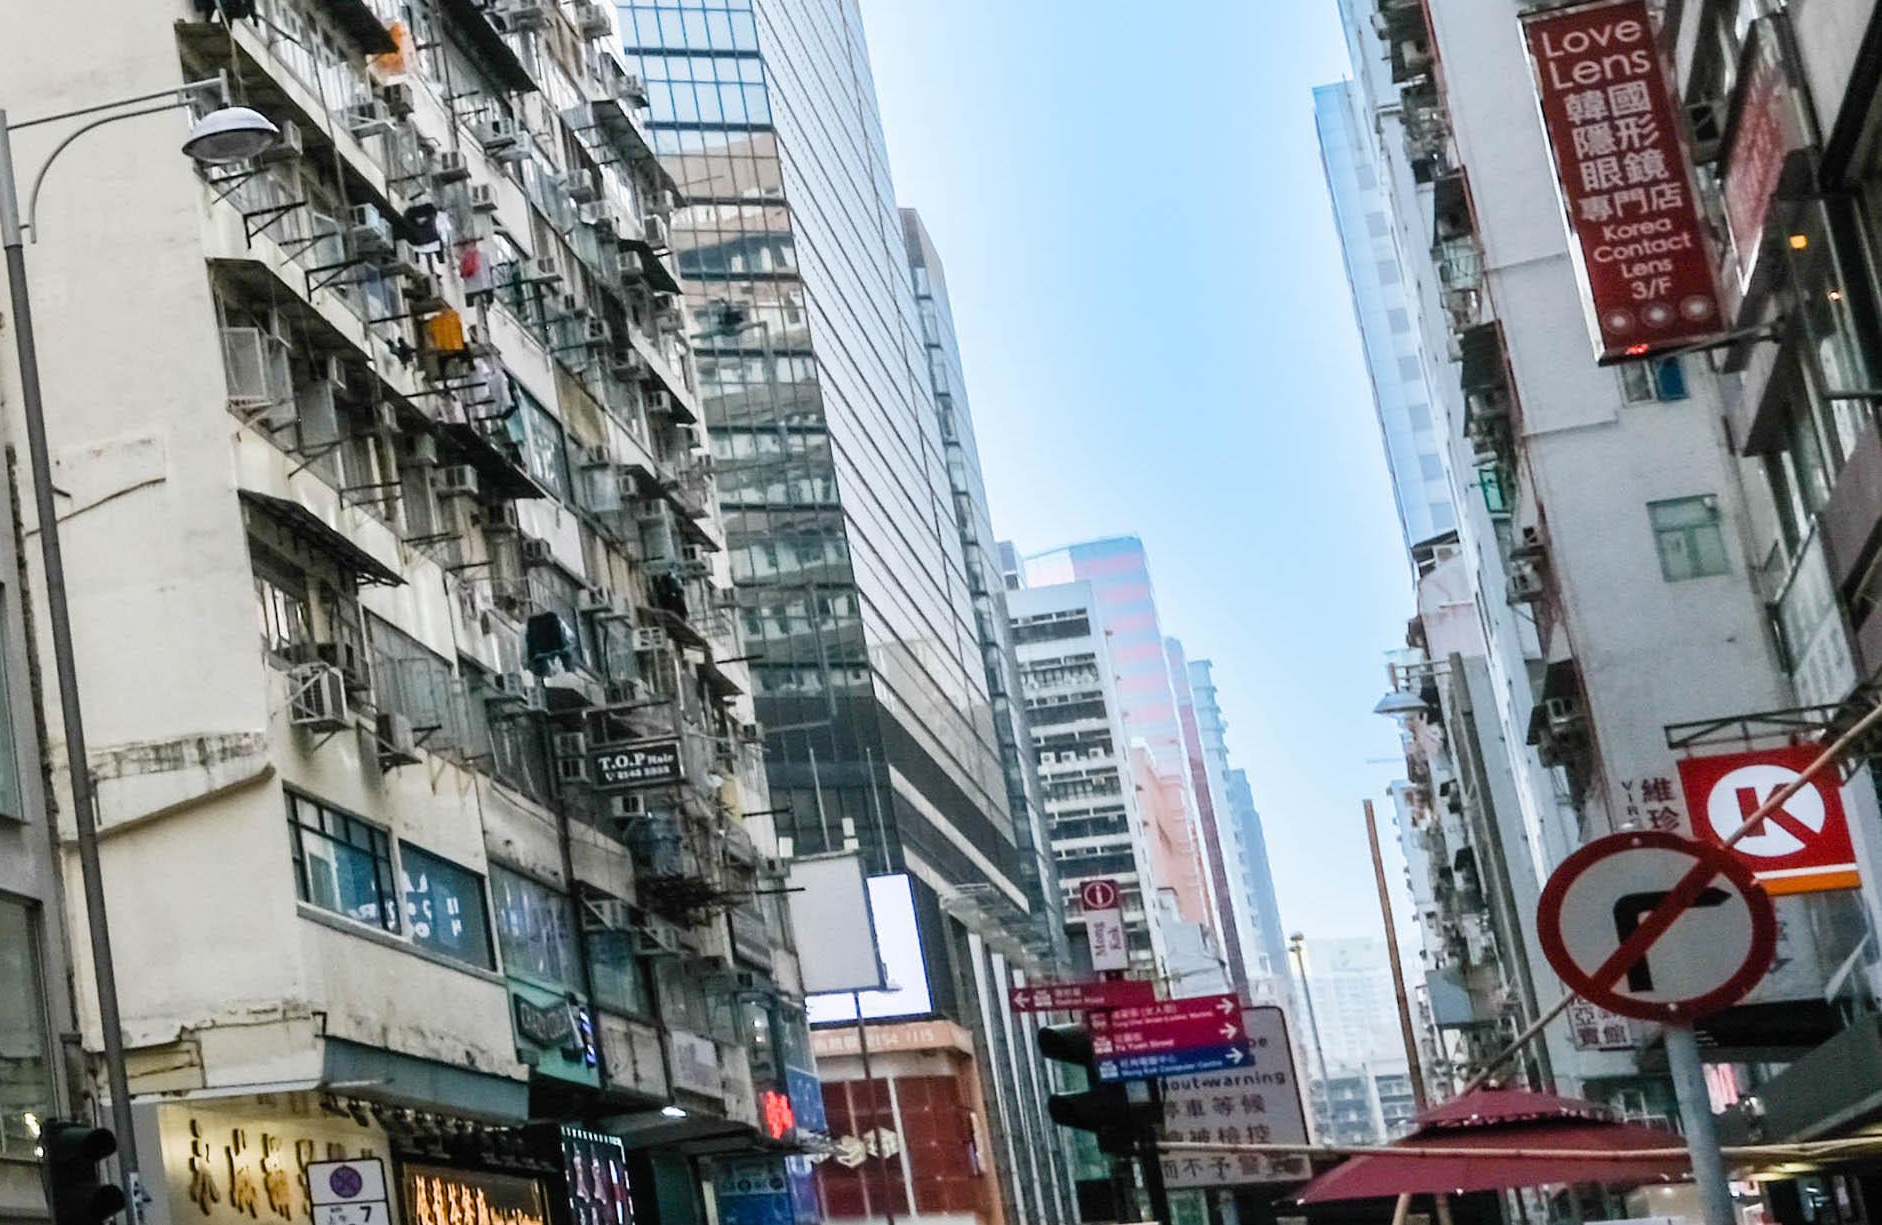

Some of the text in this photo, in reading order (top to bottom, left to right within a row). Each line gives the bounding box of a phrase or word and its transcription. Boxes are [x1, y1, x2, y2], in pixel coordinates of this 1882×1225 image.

[1541, 19, 1642, 59] Love
[1548, 50, 1651, 90] Lens
[1564, 81, 1652, 125] 韓國
[1571, 114, 1659, 161] 隱形
[1579, 149, 1670, 193] 眼鏡
[1578, 184, 1684, 224] 專門店
[1592, 231, 1693, 264] Contact
[1601, 218, 1673, 242] Korea
[1621, 258, 1673, 280] Lens
[1631, 278, 1673, 300] 3/F
[598, 752, 646, 772] T.O.P
[1208, 1071, 1286, 1089] warning
